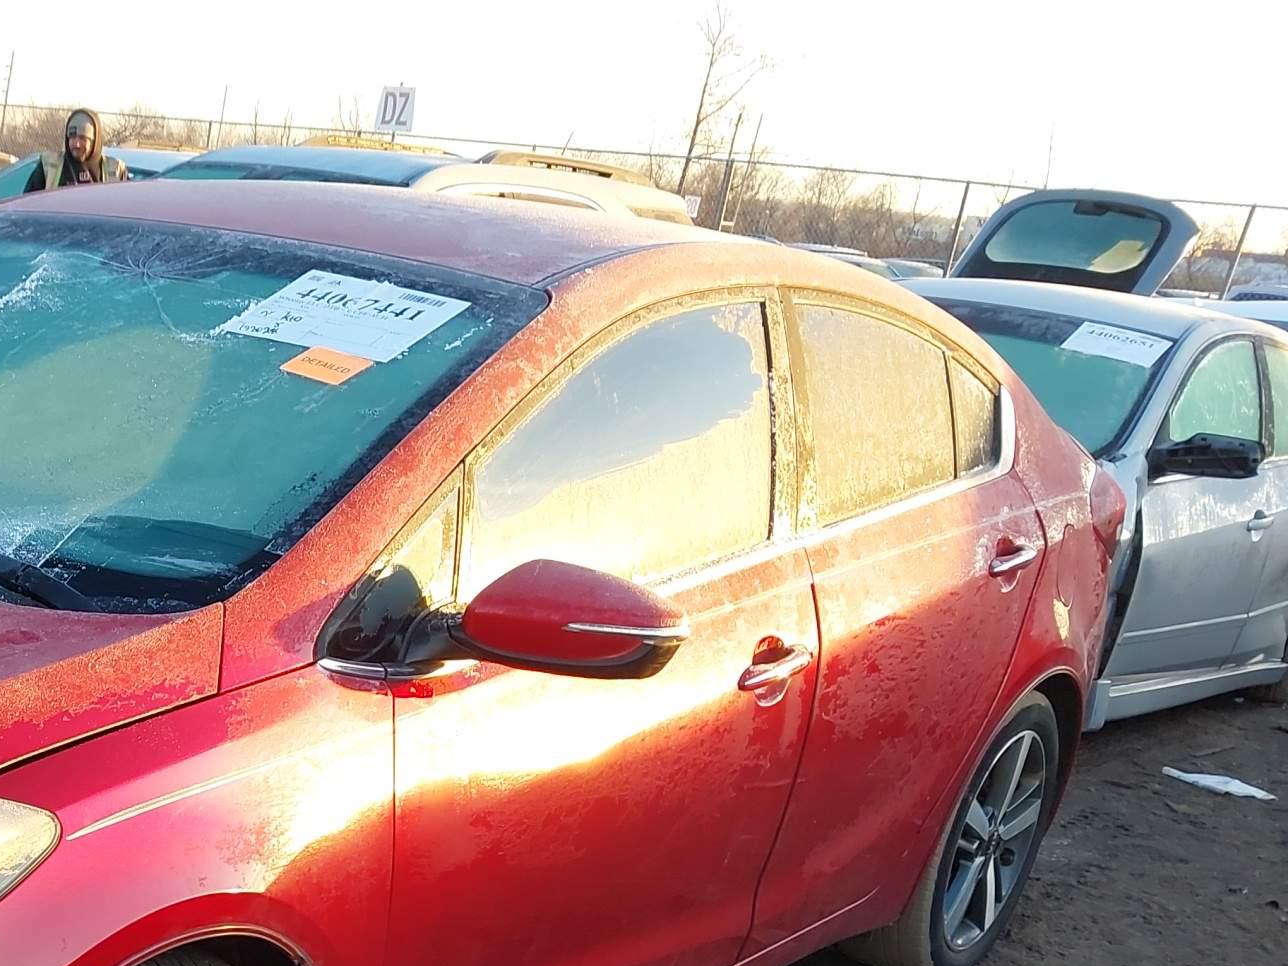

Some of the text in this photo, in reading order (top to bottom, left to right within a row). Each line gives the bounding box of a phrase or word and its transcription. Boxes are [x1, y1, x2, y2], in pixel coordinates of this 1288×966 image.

[381, 91, 410, 126] DZ
[295, 287, 426, 321] 44067441
[301, 356, 351, 374] DETAILED
